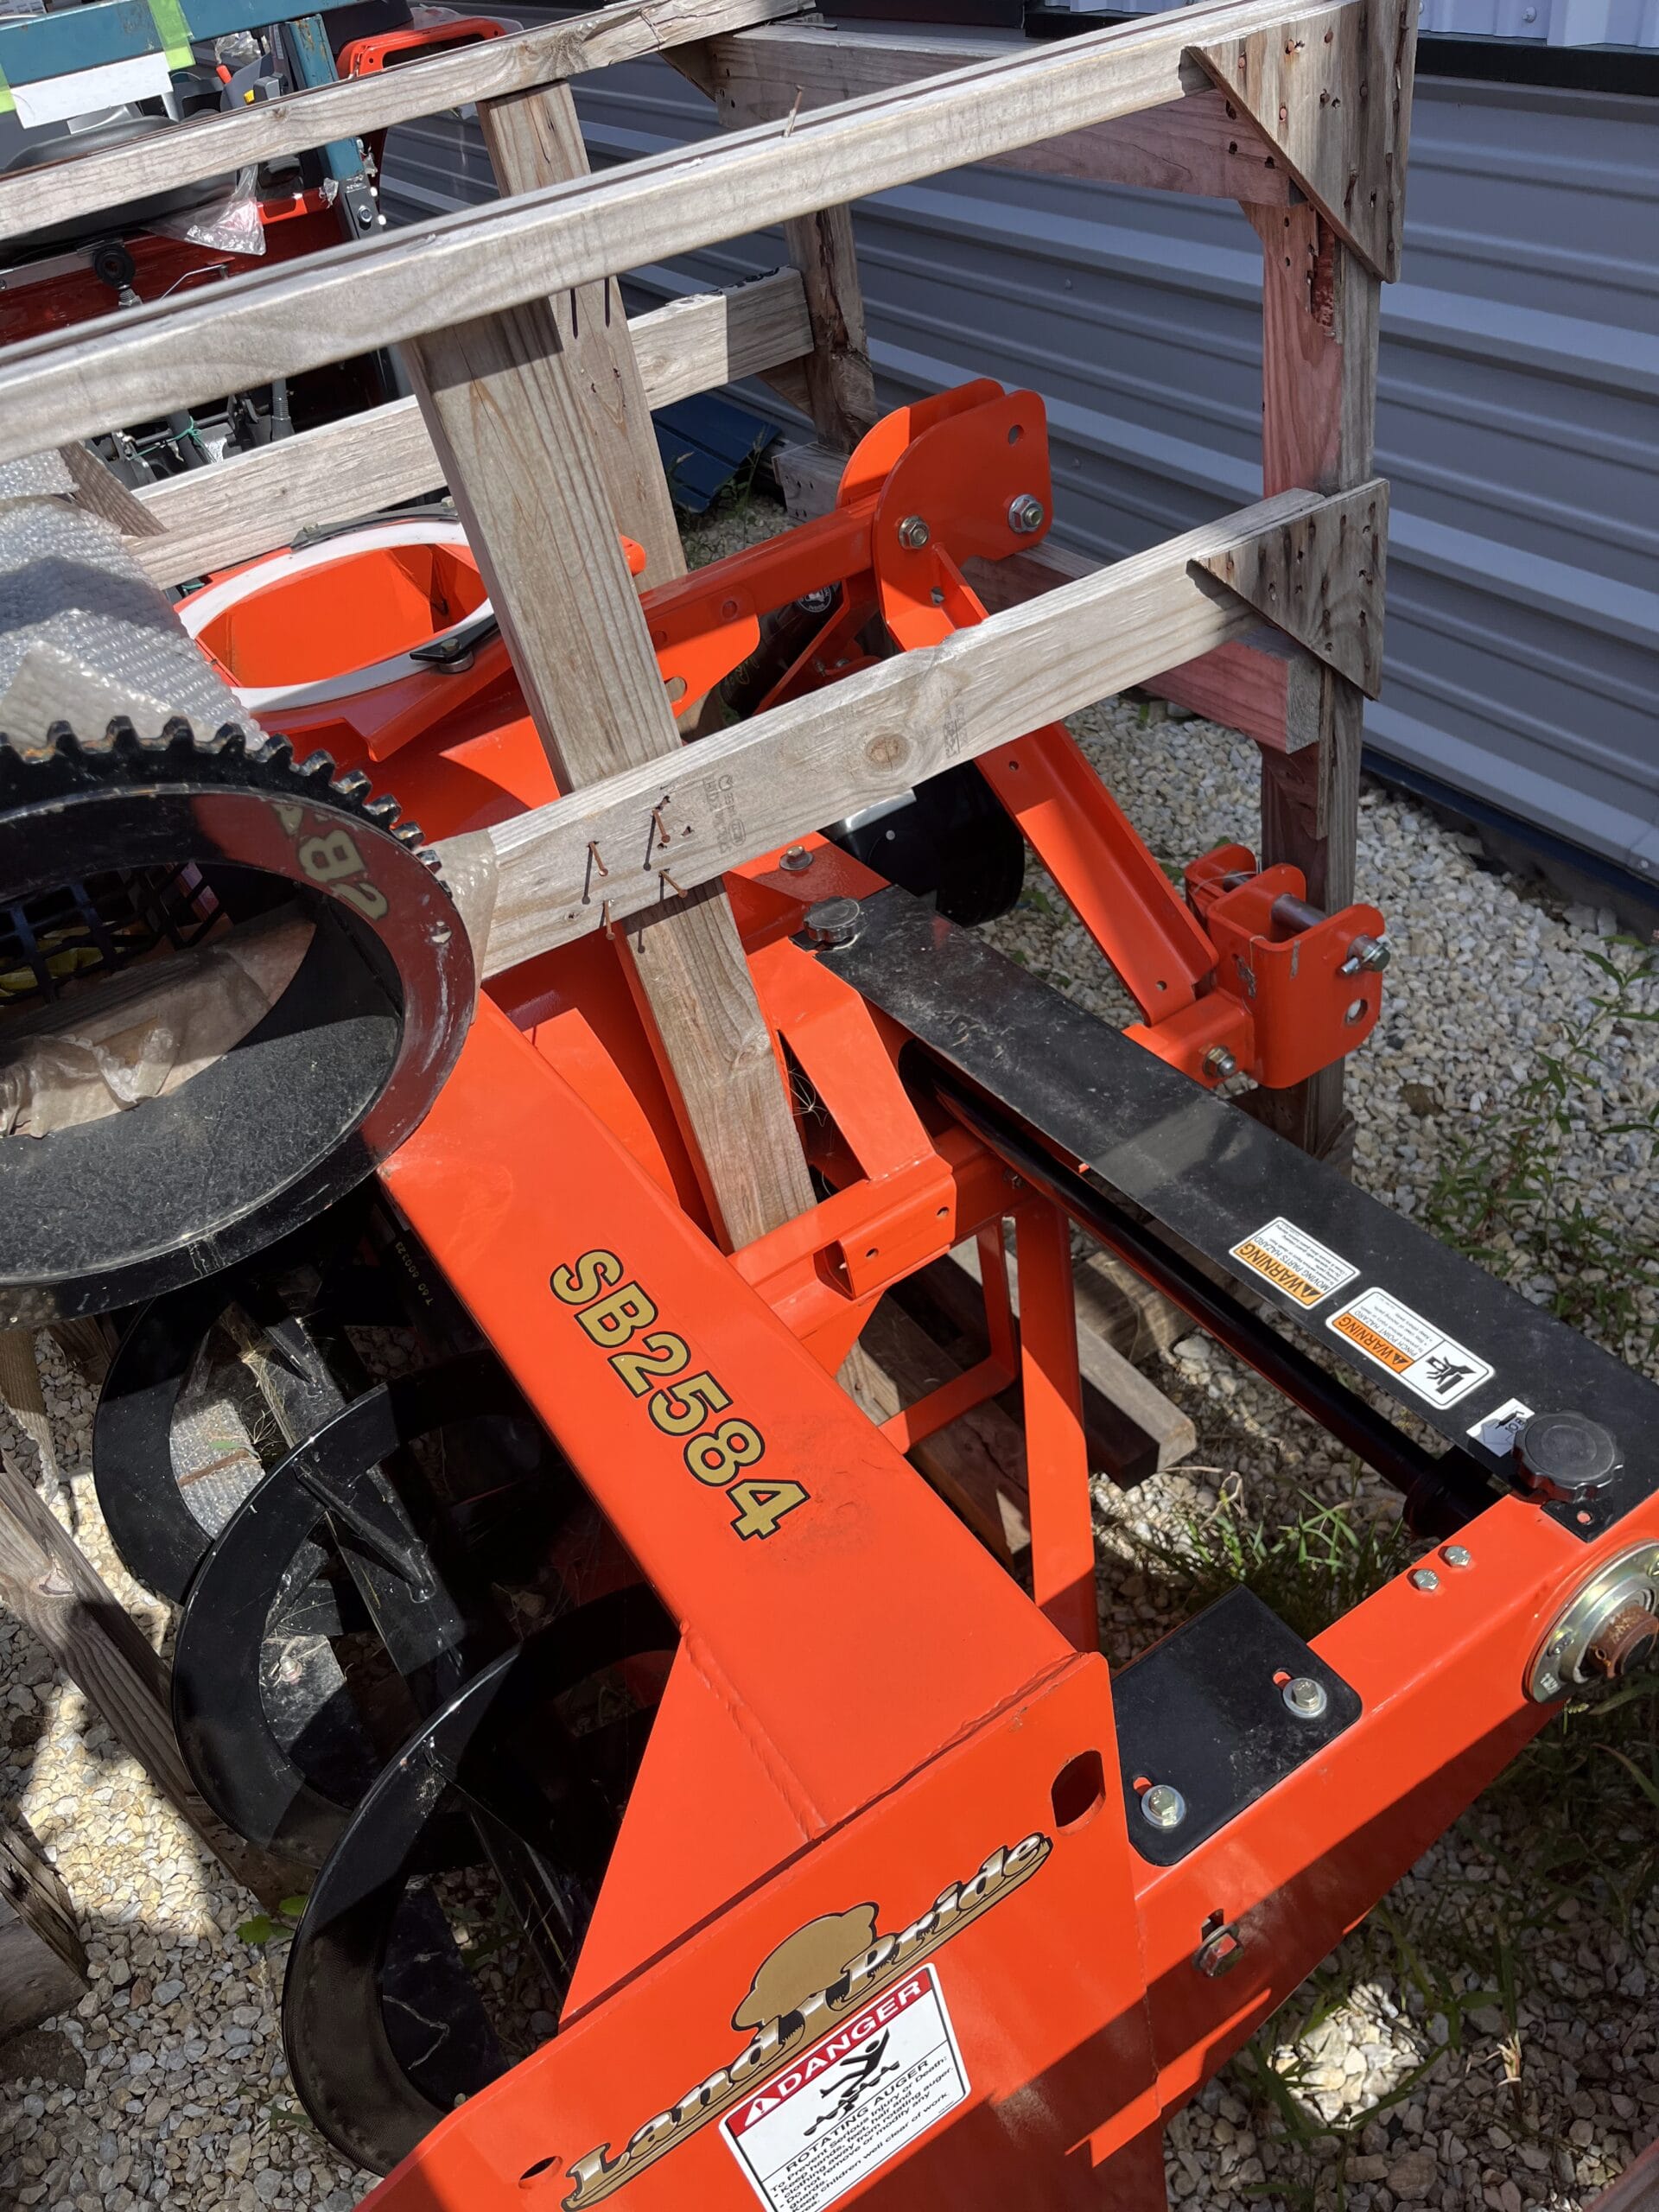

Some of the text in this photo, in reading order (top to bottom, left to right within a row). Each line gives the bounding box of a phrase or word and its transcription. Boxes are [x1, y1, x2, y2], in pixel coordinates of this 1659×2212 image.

[1240, 1243, 1303, 1291] WARNING
[1254, 1236, 1330, 1290] MOVING PARTS HAZARD
[1338, 1317, 1393, 1358] WARNING
[1354, 1310, 1417, 1357] PINCH POINT HAZARD
[550, 1249, 811, 1541] SB2584
[565, 1832, 1045, 2202] Land Pride
[776, 1980, 923, 2097] DANGER
[770, 2181, 785, 2191] To
[787, 2148, 828, 2180] Prevent
[830, 2117, 869, 2148] Serious
[871, 2093, 899, 2116] Injury
[902, 2082, 912, 2092] or
[780, 2171, 808, 2193] Keep
[810, 2145, 845, 2171] hands,
[871, 2107, 890, 2124] hair
[893, 2090, 912, 2107] and
[784, 2165, 826, 2198] clothing
[829, 2143, 855, 2165] away
[856, 2123, 881, 2143] from
[883, 2091, 921, 2123] rotating
[785, 2060, 928, 2172] ROTATING AUGER
[786, 2191, 801, 2203] Do
[804, 2176, 821, 2191] not
[823, 2145, 861, 2177] remove
[863, 2135, 874, 2145] or
[876, 2107, 910, 2135] modify
[912, 2091, 931, 2108] any
[820, 2159, 861, 2192] children
[863, 2141, 883, 2158] well
[885, 2121, 909, 2143] clear
[911, 2112, 921, 2122] of
[923, 2093, 948, 2112] work
